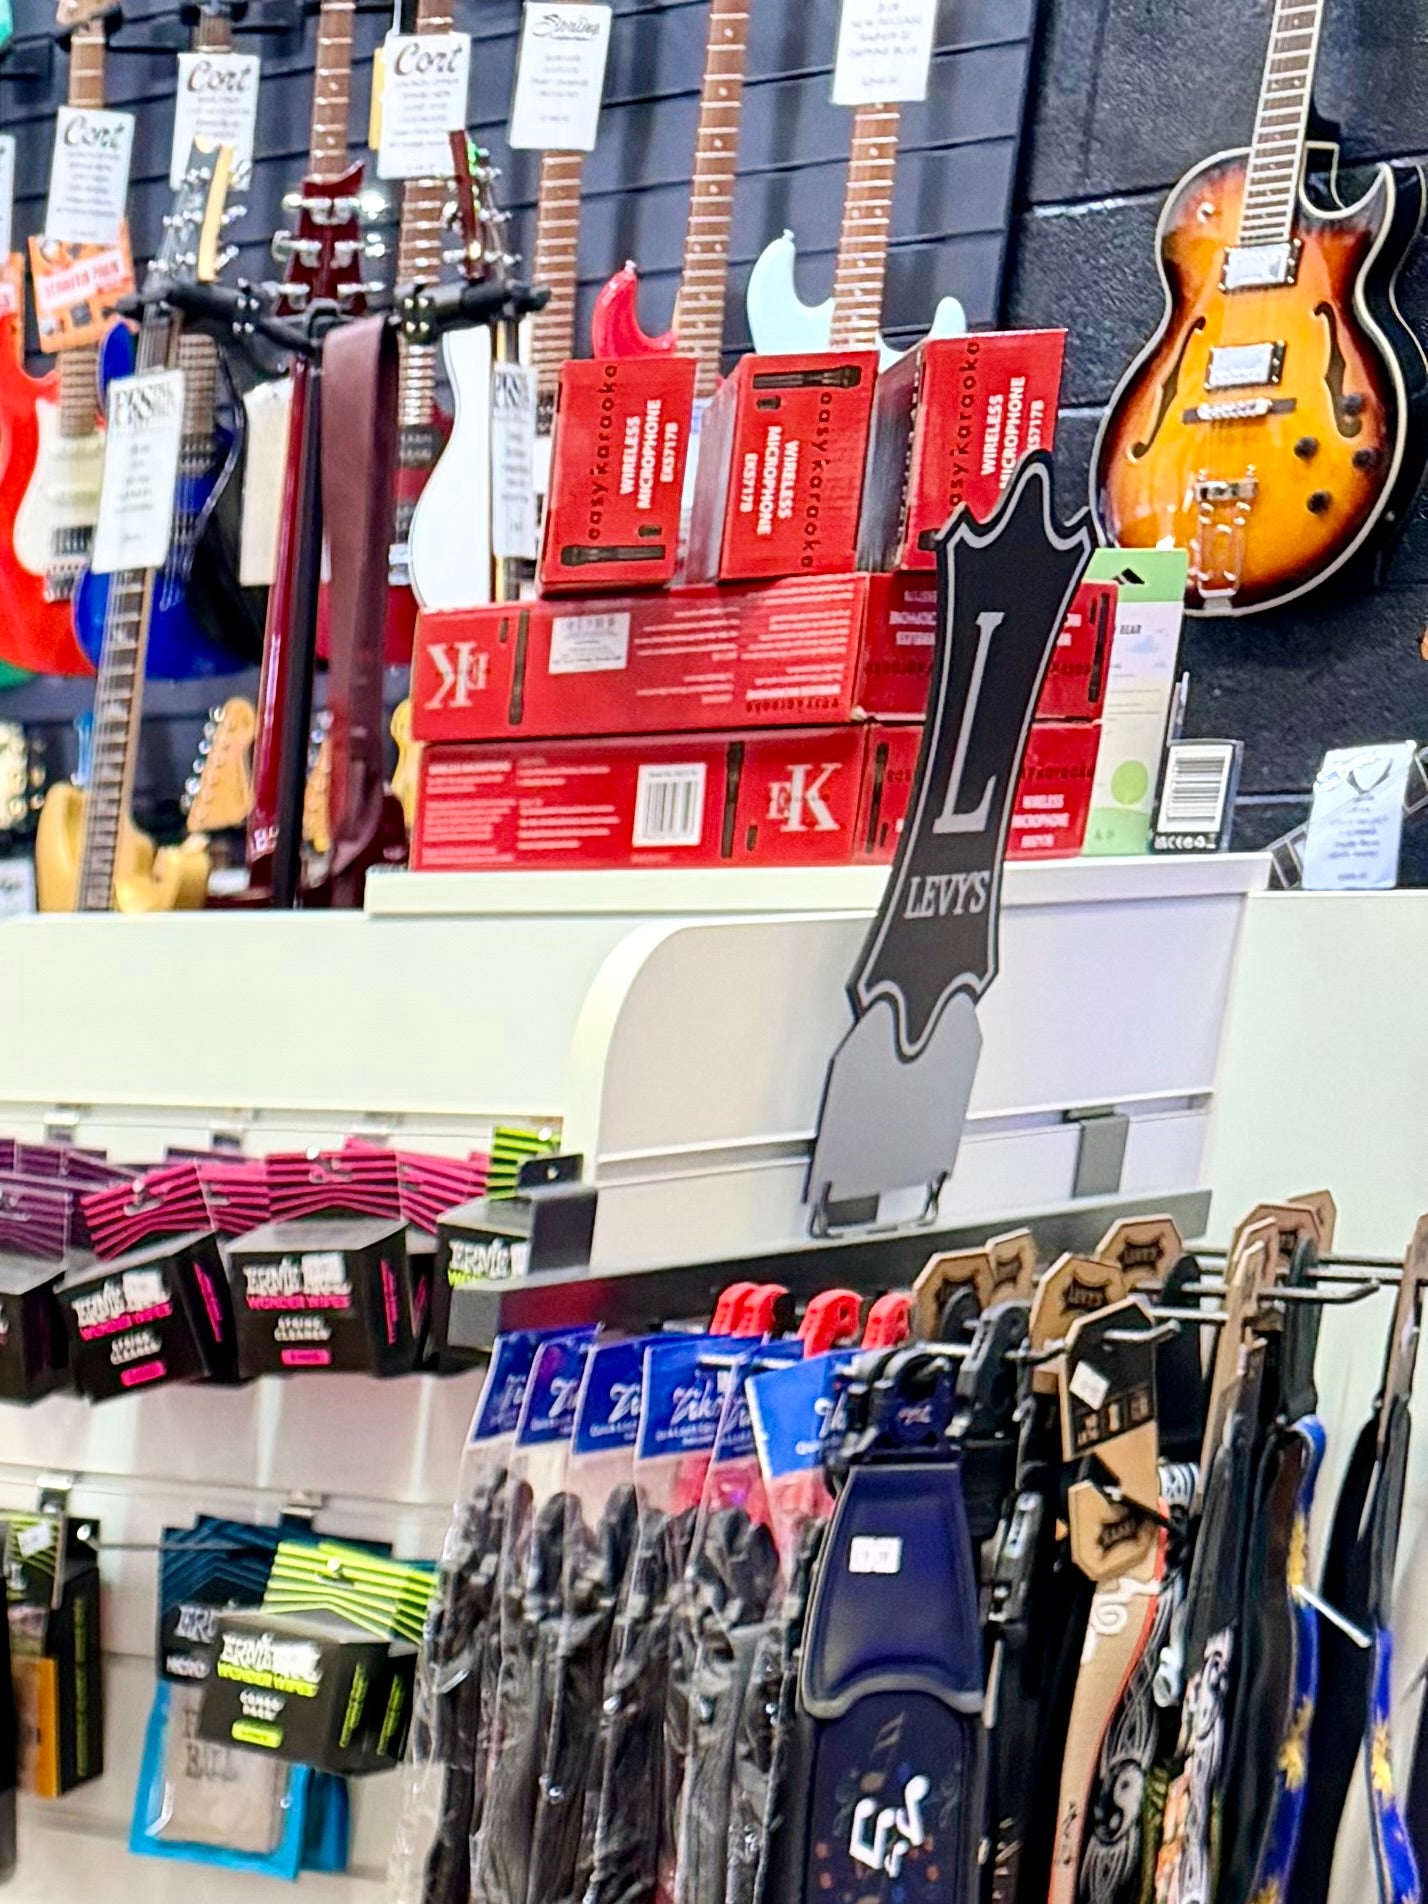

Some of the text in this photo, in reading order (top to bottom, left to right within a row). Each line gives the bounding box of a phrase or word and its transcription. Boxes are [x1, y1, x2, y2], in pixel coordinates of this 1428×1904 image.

[186, 58, 252, 94] Cort
[393, 42, 463, 77] Cort
[62, 114, 125, 149] Cort
[619, 415, 641, 495] WIRELESS
[637, 400, 662, 509] MICROPHONE
[979, 394, 1004, 477] WIRELESS
[757, 425, 783, 536] MICROPHONE
[778, 439, 800, 520] WIRELESS
[243, 1254, 302, 1297] ERNIE
[449, 1237, 511, 1280] ERNIE
[247, 1293, 351, 1311] WONDER WIPES
